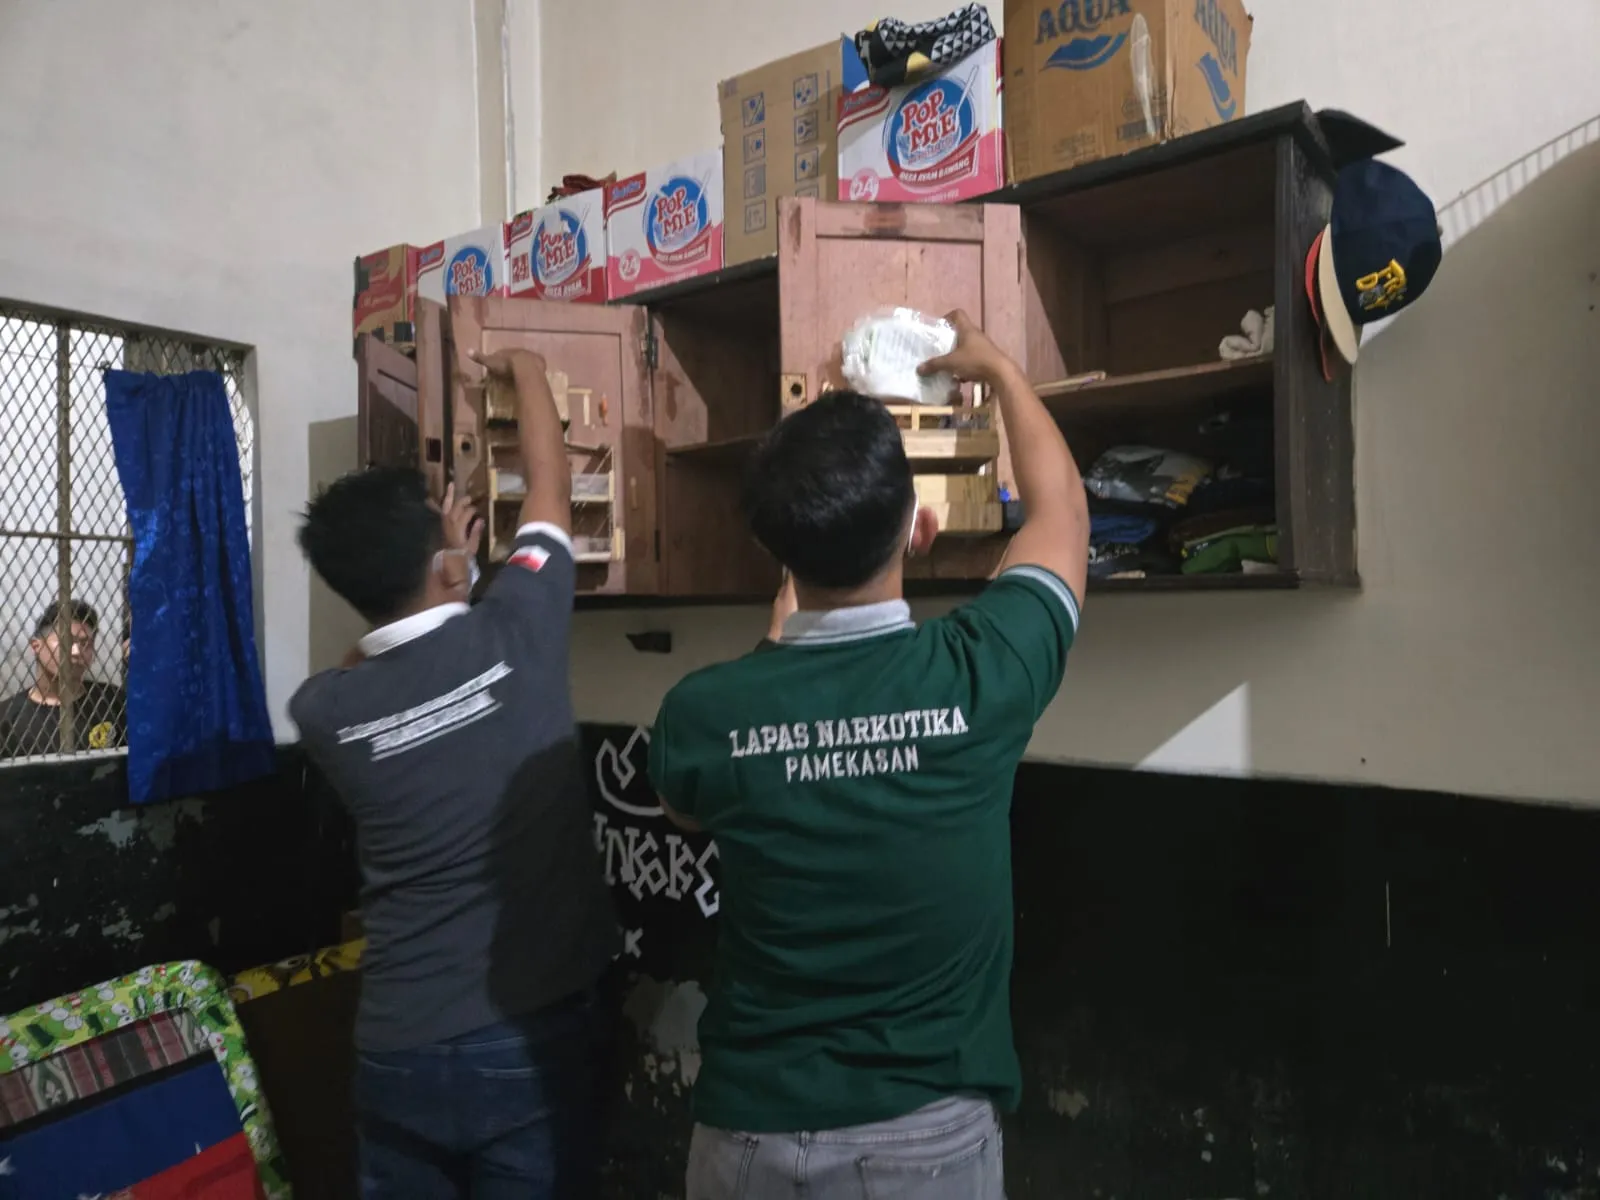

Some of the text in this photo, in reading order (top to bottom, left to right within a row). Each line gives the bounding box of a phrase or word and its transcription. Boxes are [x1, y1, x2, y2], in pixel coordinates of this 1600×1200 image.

[902, 89, 943, 133] POP
[910, 106, 957, 153] MIE
[656, 186, 686, 222] POP
[853, 177, 875, 201] 24
[662, 202, 696, 237] MIE
[452, 254, 477, 285] POP
[729, 706, 968, 758] LAPAS NARKOTIKA
[785, 744, 919, 783] PAMEKASAN
